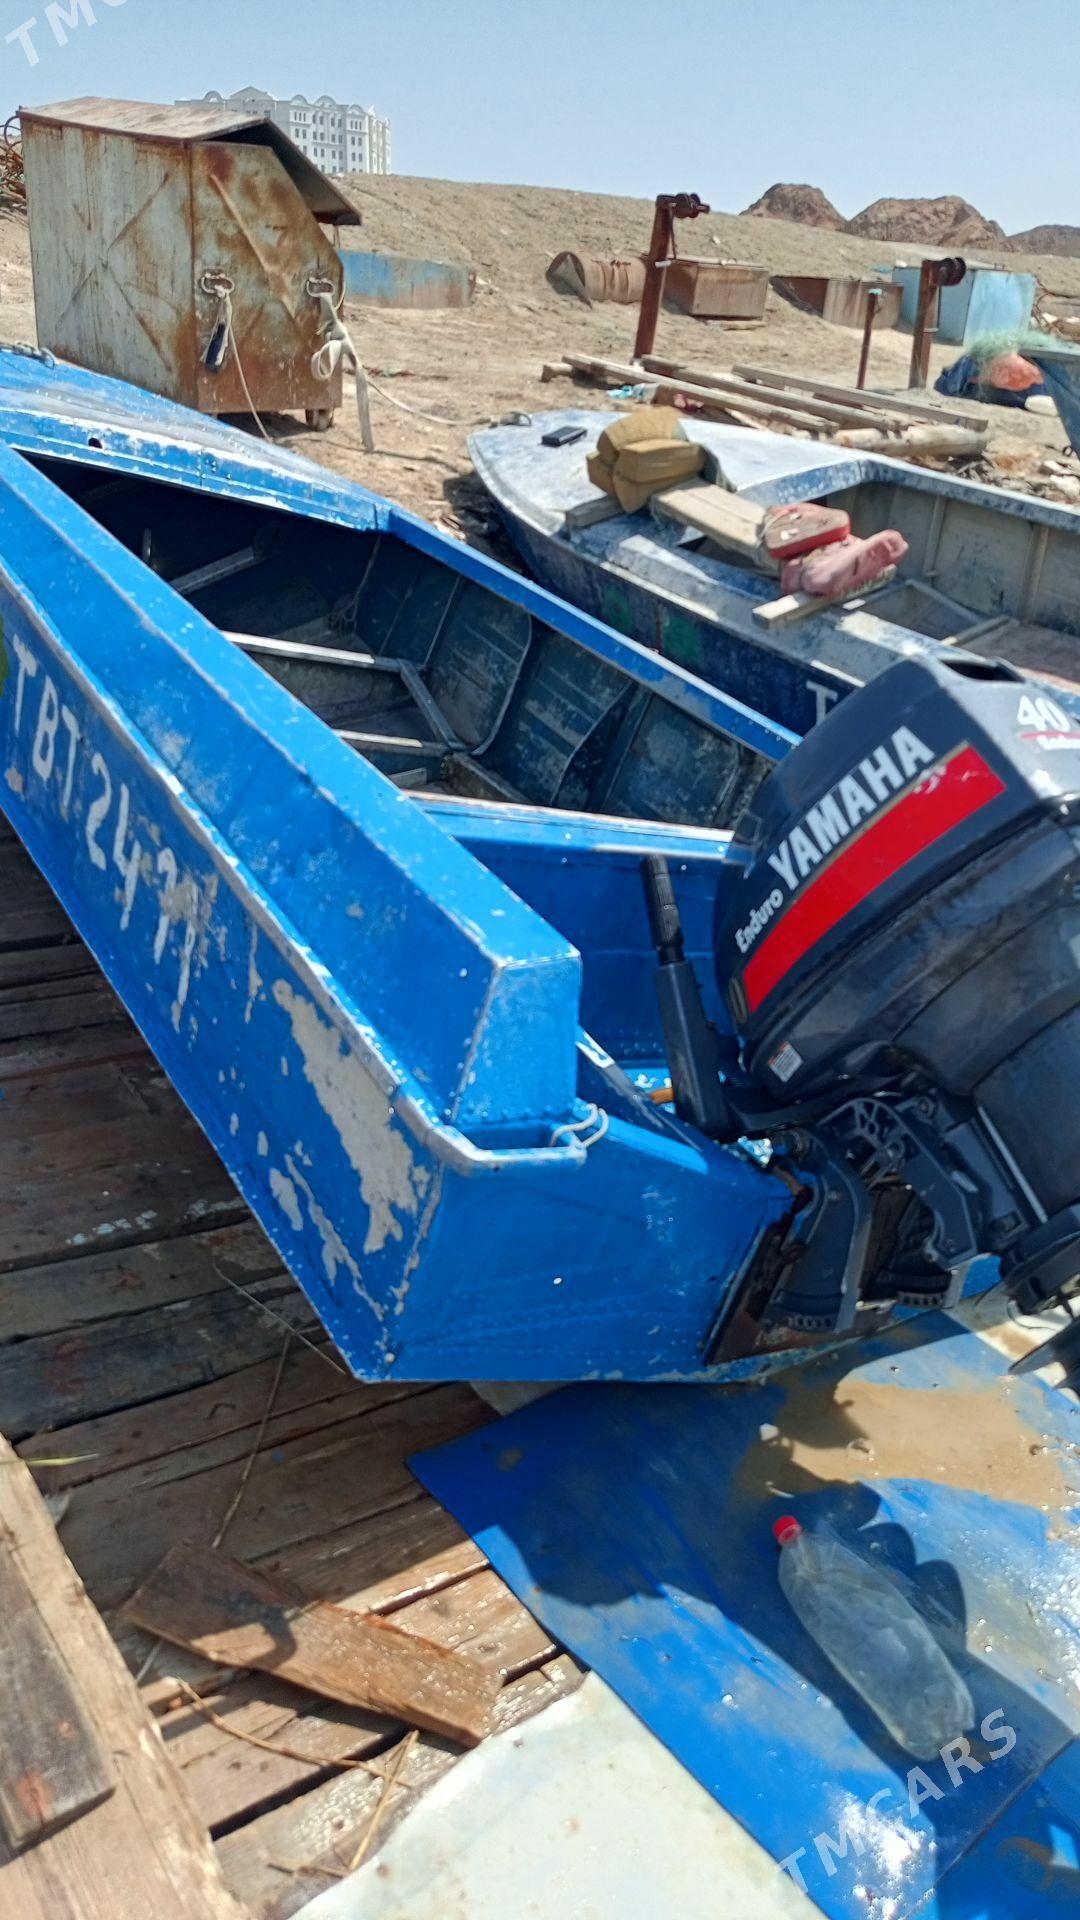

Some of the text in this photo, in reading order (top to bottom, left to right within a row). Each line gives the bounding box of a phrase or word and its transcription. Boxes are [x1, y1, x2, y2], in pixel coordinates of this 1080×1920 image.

[1017, 695, 1071, 732] 40
[734, 726, 936, 954] Enduro YAMAHA
